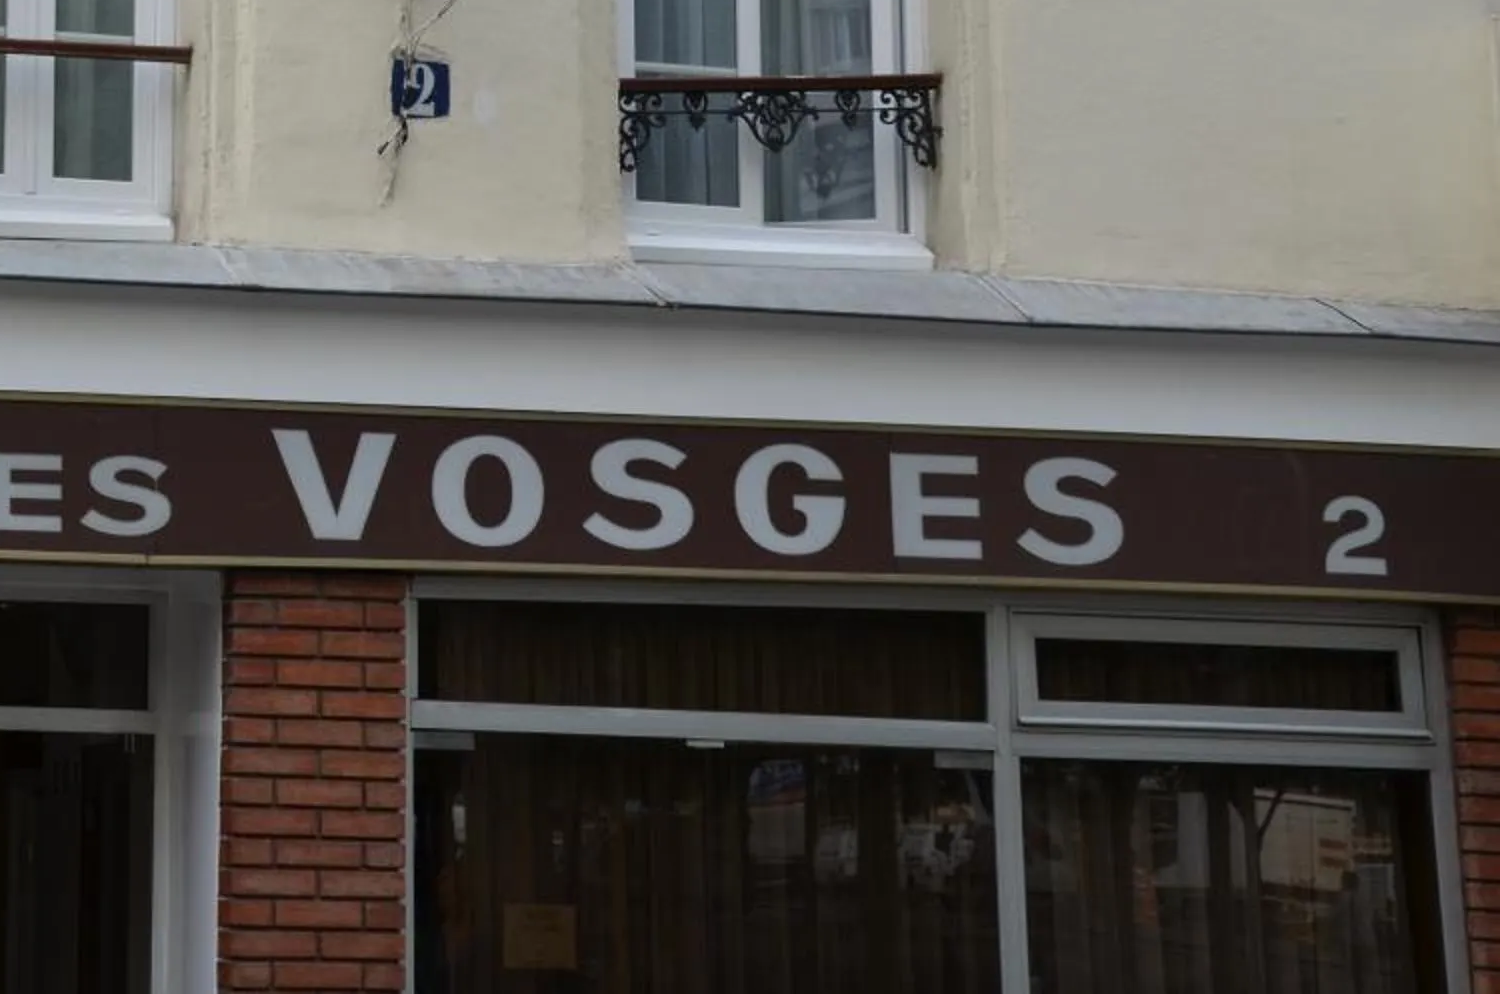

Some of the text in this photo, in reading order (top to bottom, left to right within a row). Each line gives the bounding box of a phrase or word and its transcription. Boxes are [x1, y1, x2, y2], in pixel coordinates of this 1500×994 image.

[402, 63, 435, 117] 2
[272, 429, 1123, 565] VOSGES
[1324, 497, 1386, 575] 2
